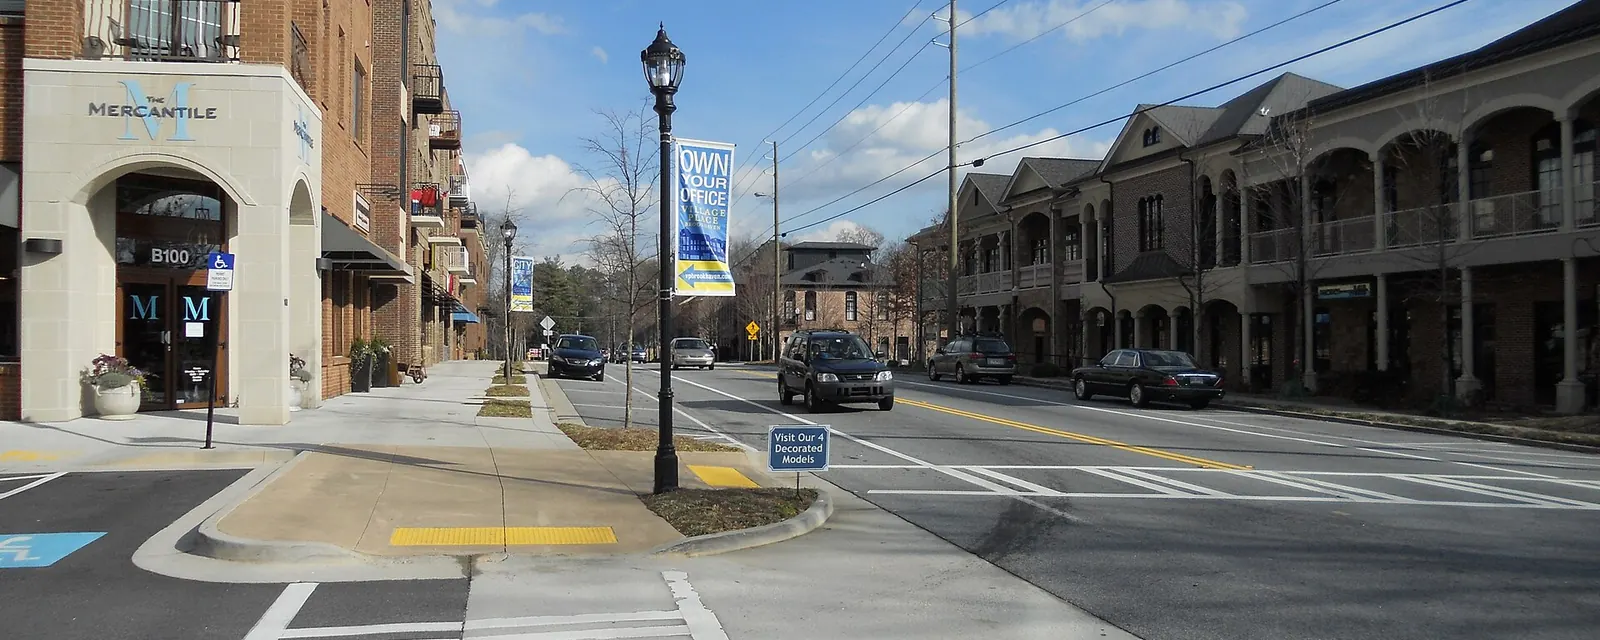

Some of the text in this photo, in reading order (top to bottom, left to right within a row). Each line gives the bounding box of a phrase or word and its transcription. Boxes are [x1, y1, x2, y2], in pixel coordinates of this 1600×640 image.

[88, 102, 217, 119] MERCANTILE
[117, 80, 196, 141] M
[680, 149, 729, 176] OWN
[681, 173, 727, 190] YOUR
[680, 187, 727, 207] OFFICE
[681, 205, 727, 217] VILLAGE
[688, 214, 719, 225] PLACE
[151, 248, 189, 264] B100
[514, 260, 532, 270] CITY
[130, 294, 159, 320] M
[183, 296, 211, 321] M
[774, 432, 824, 442] Visit Our 4
[775, 444, 823, 453] Decorated
[782, 455, 815, 464] Models
